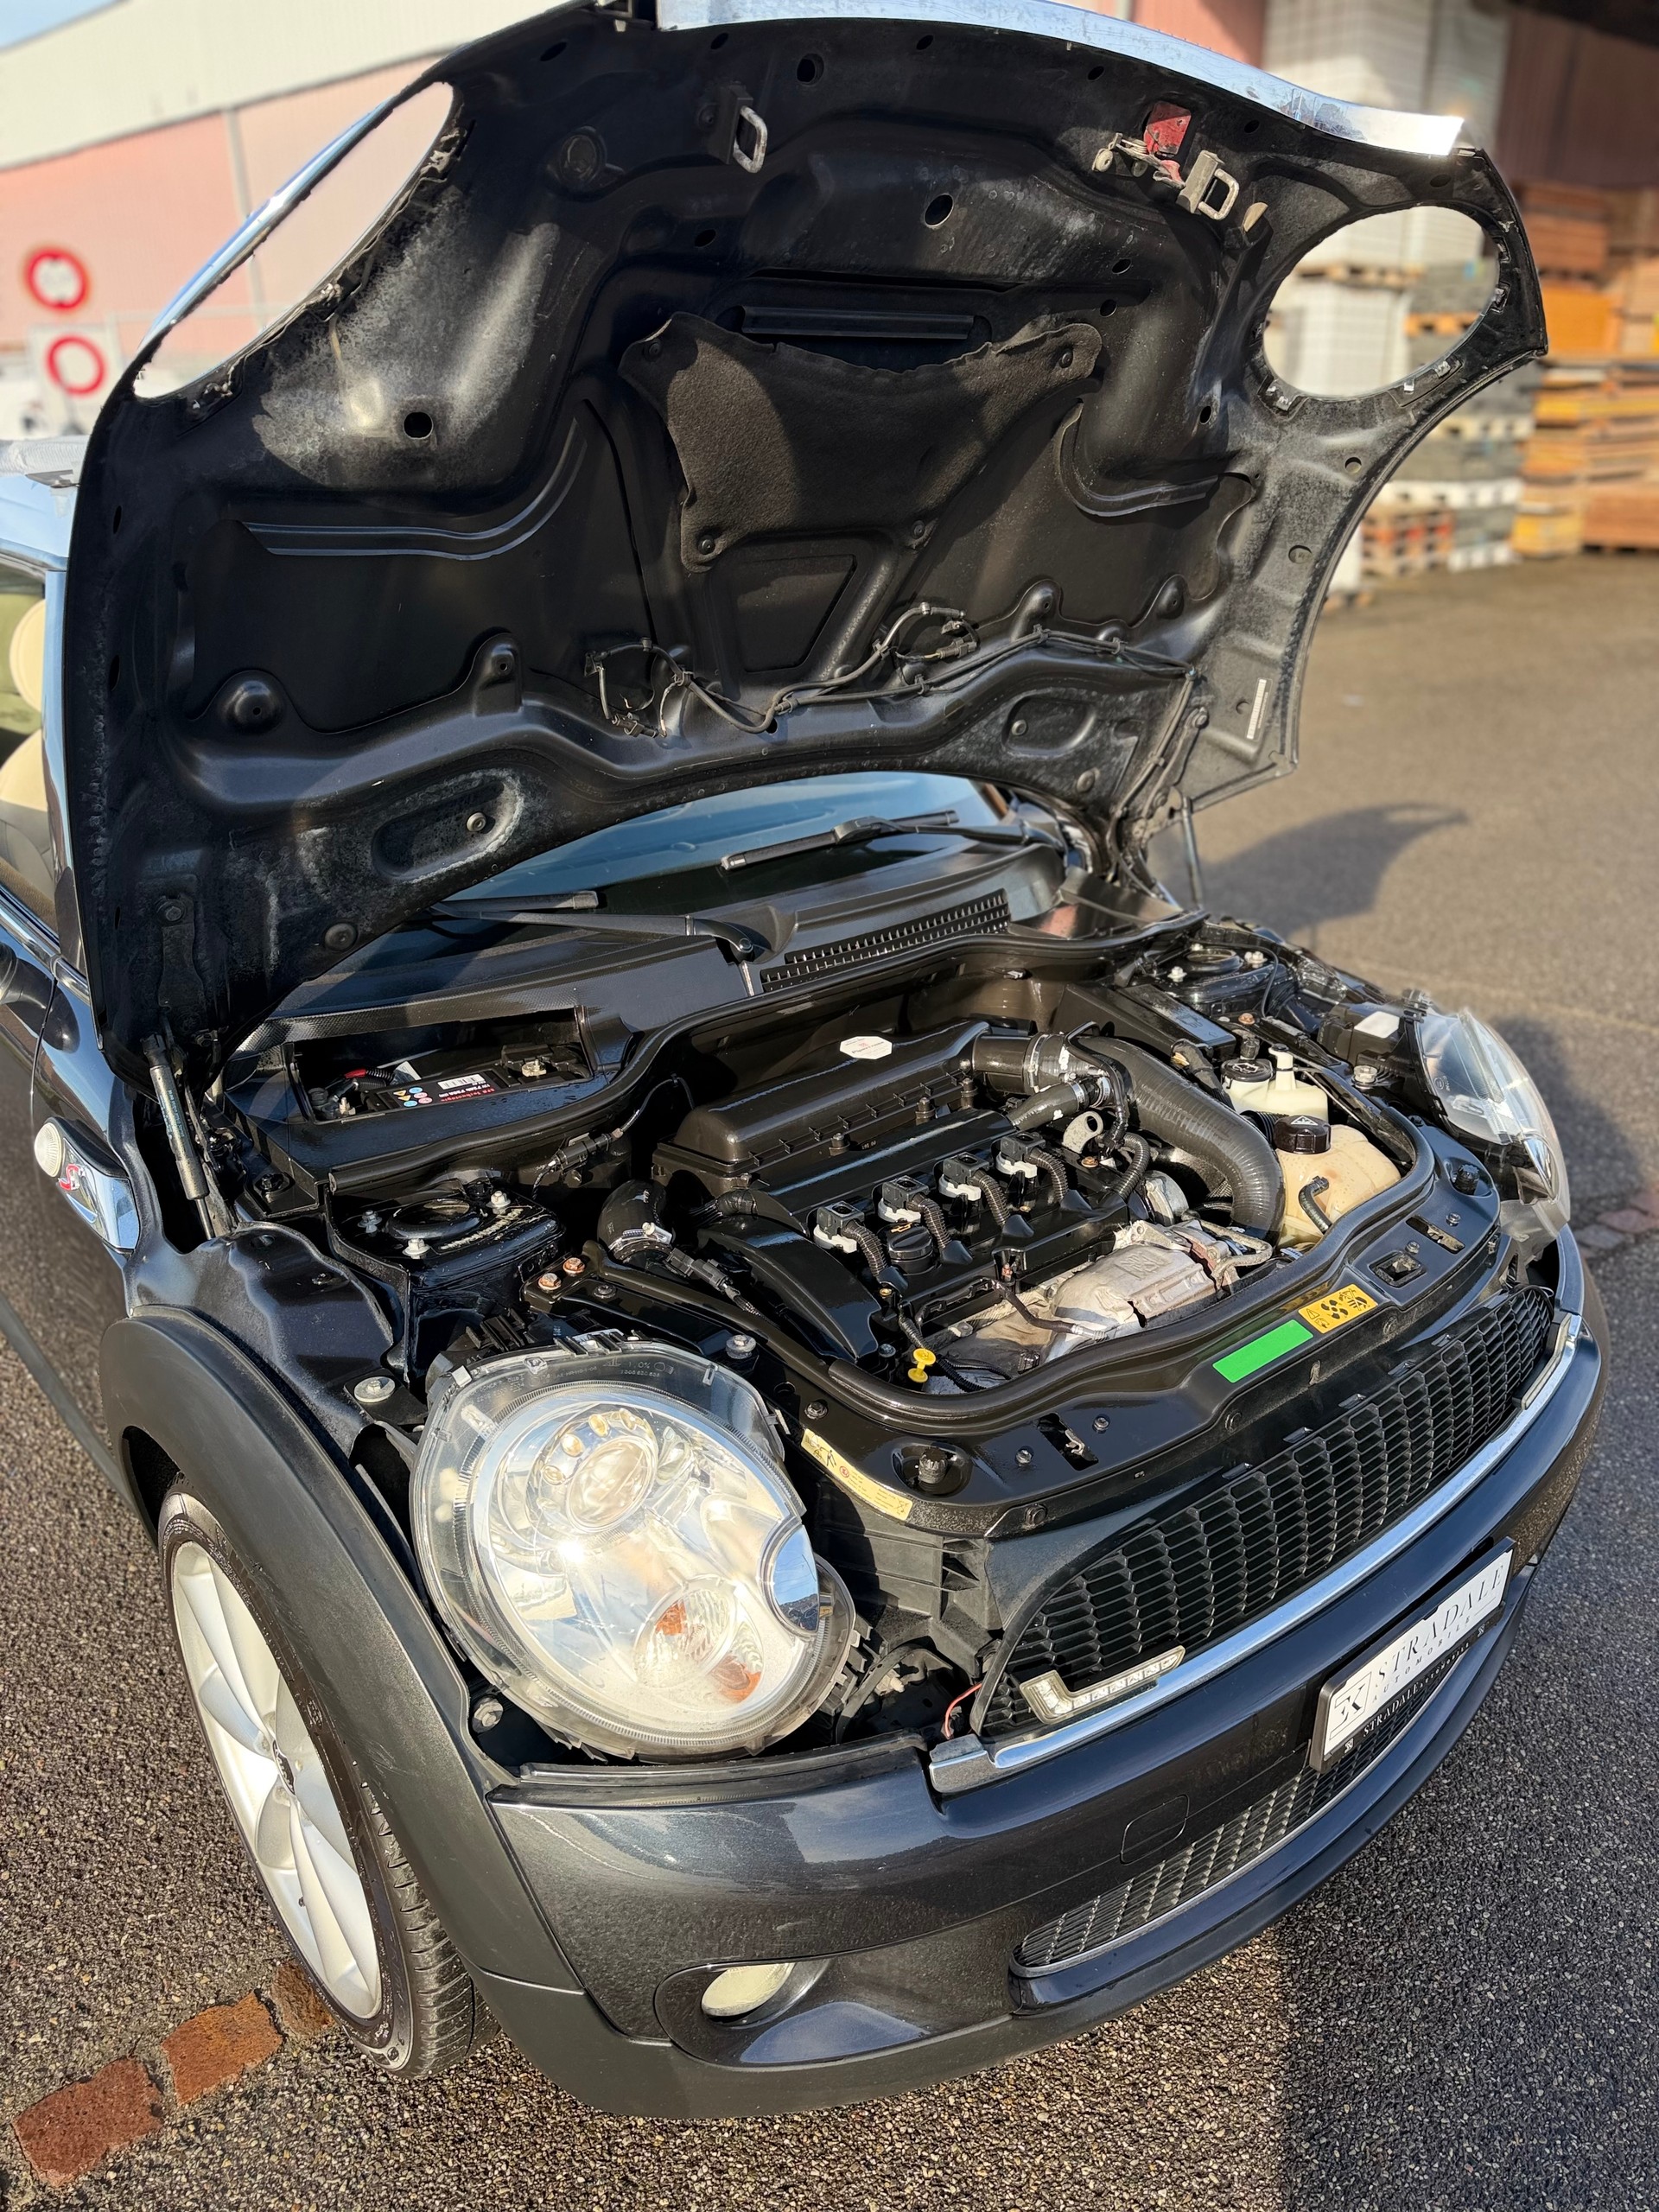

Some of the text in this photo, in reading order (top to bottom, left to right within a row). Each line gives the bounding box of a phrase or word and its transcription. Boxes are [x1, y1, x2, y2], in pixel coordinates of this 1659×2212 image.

[1372, 1615, 1471, 1704] AUTOMOBILE
[1375, 1565, 1504, 1688] STRADALE
[1363, 1681, 1420, 1738] STRADALE
